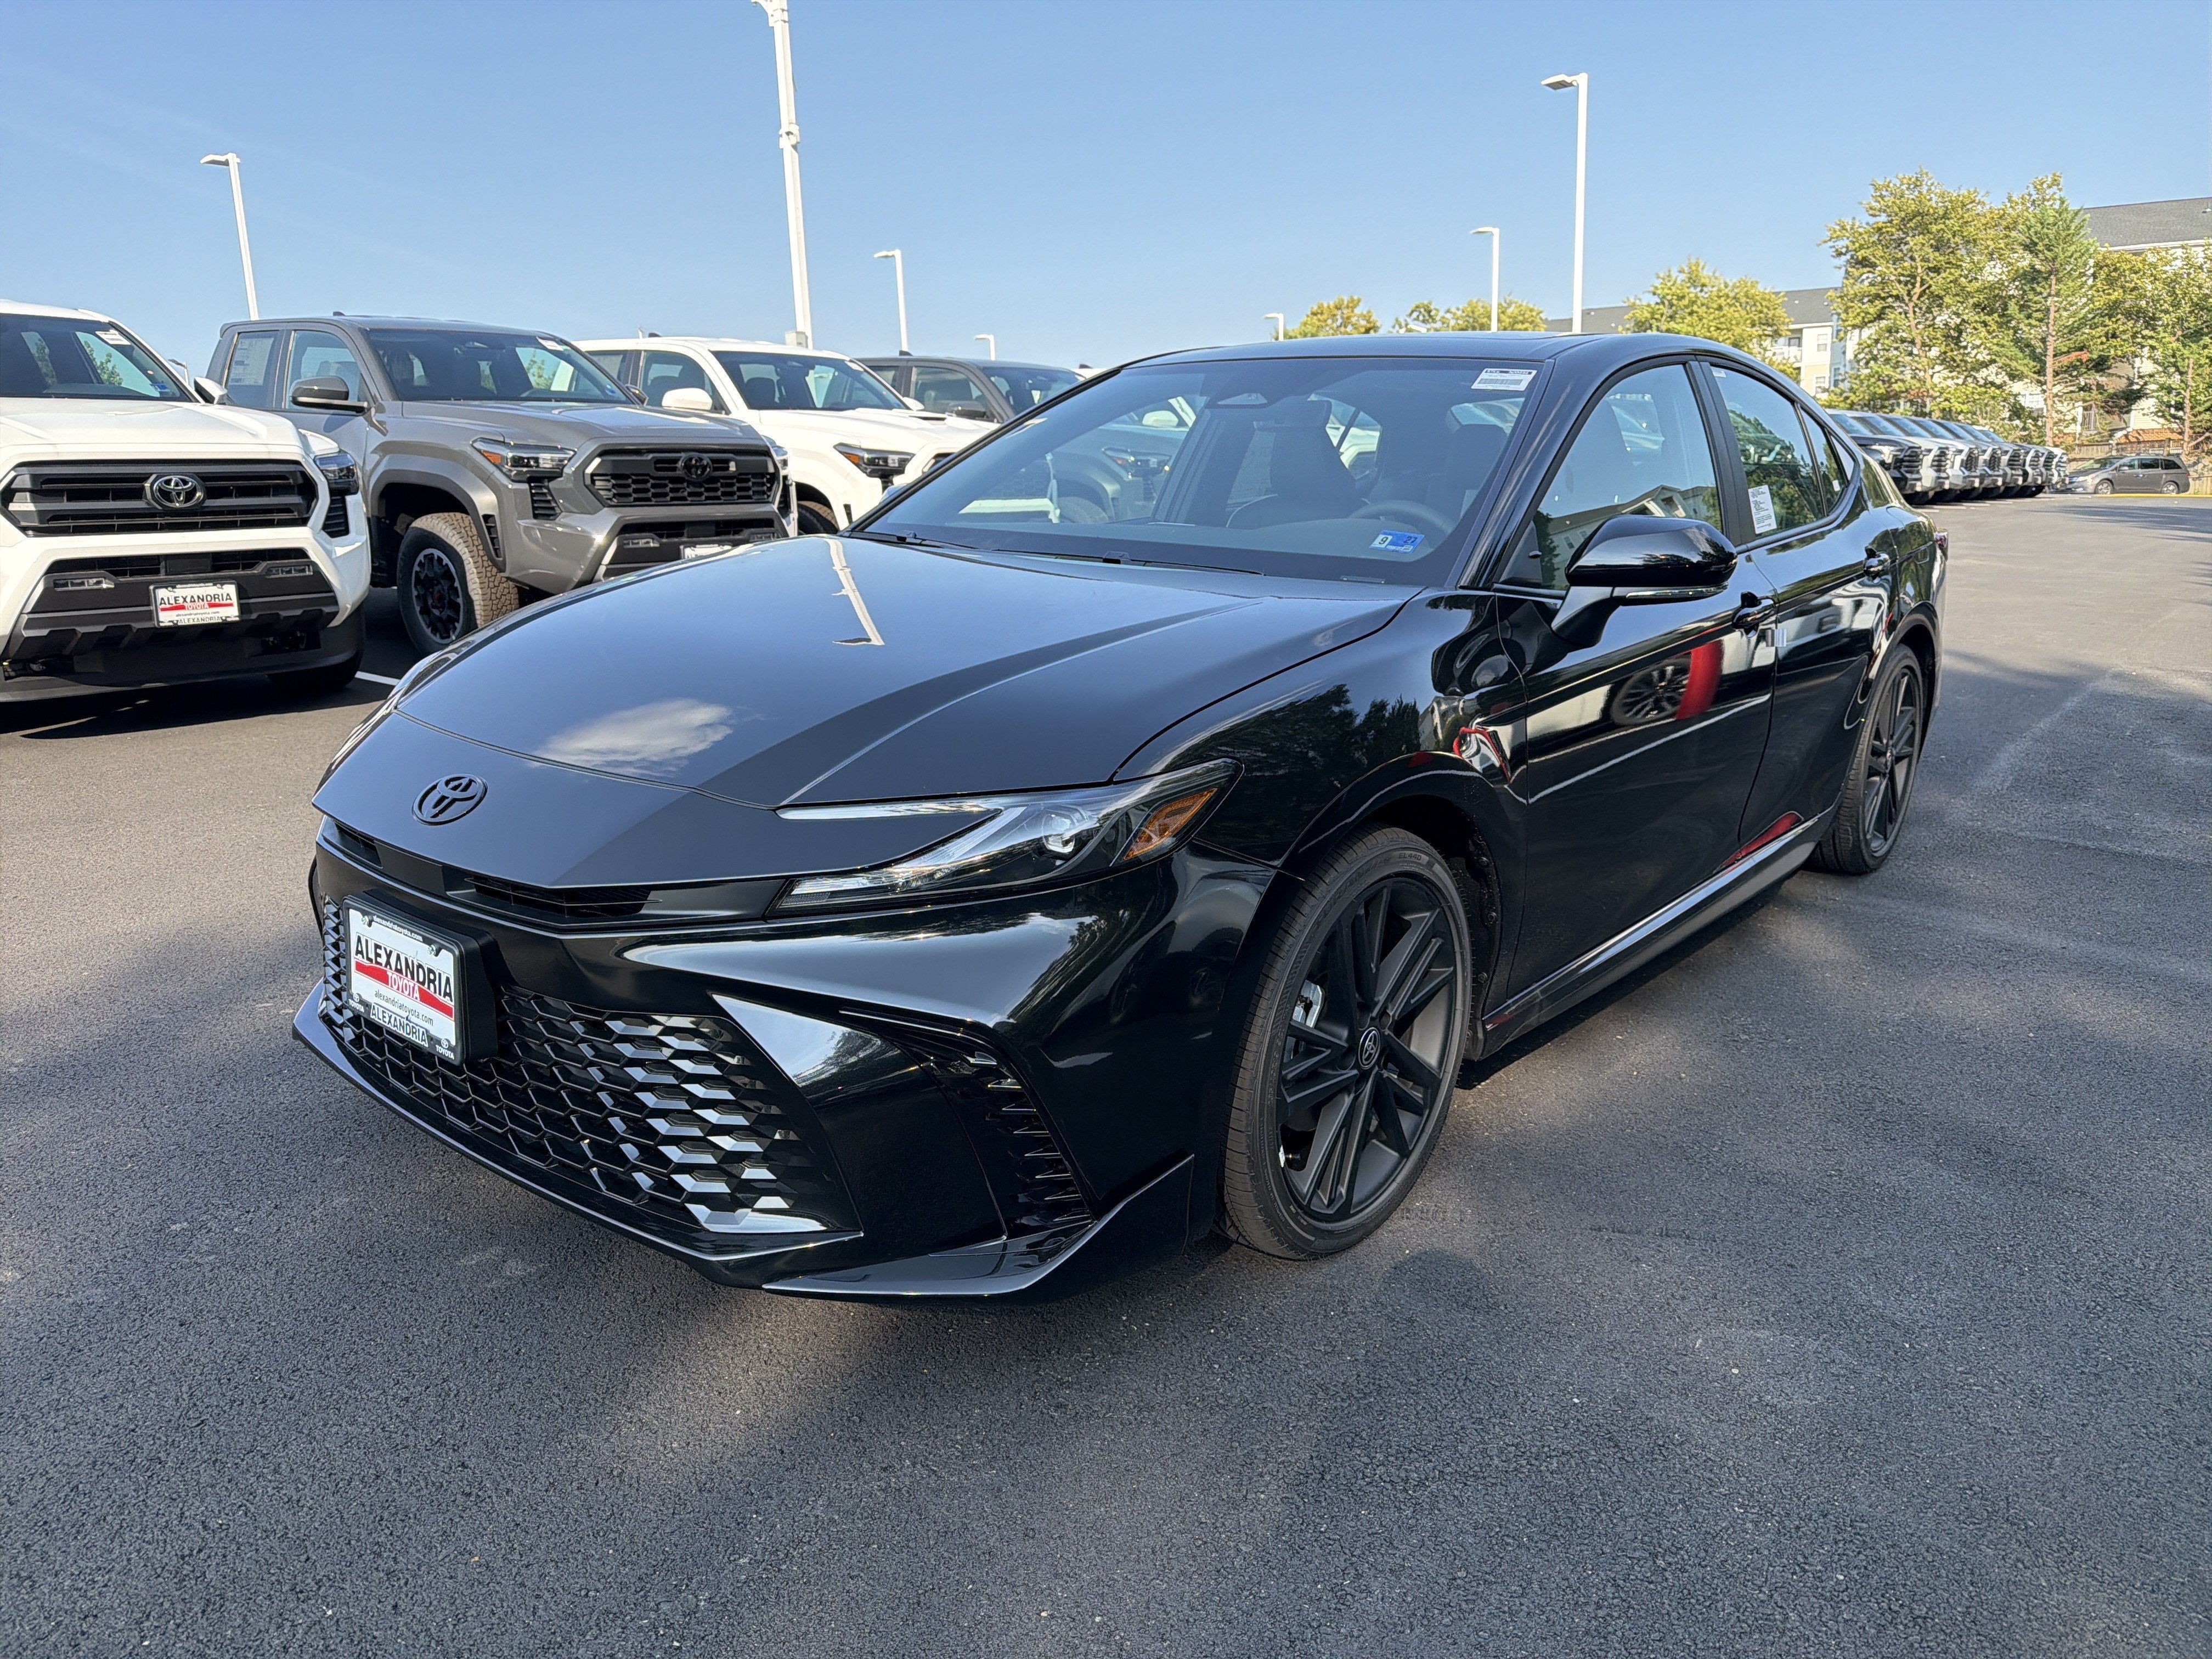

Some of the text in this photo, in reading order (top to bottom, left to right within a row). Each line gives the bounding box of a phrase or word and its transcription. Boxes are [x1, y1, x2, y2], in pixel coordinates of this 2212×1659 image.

[1378, 536, 1389, 545] 9
[1403, 535, 1418, 544] 27
[159, 592, 232, 606] ALEXANDRIA
[178, 616, 221, 624] ALEXANDRIA
[354, 934, 453, 1002] ALEXANDRIA
[387, 971, 421, 1002] TOYOTA
[348, 998, 365, 1013] TOYOTA
[374, 989, 433, 1026] alexandriatoyota.com
[371, 1005, 428, 1047] ALEXANDRIA
[436, 1045, 455, 1060] TOYOTA
